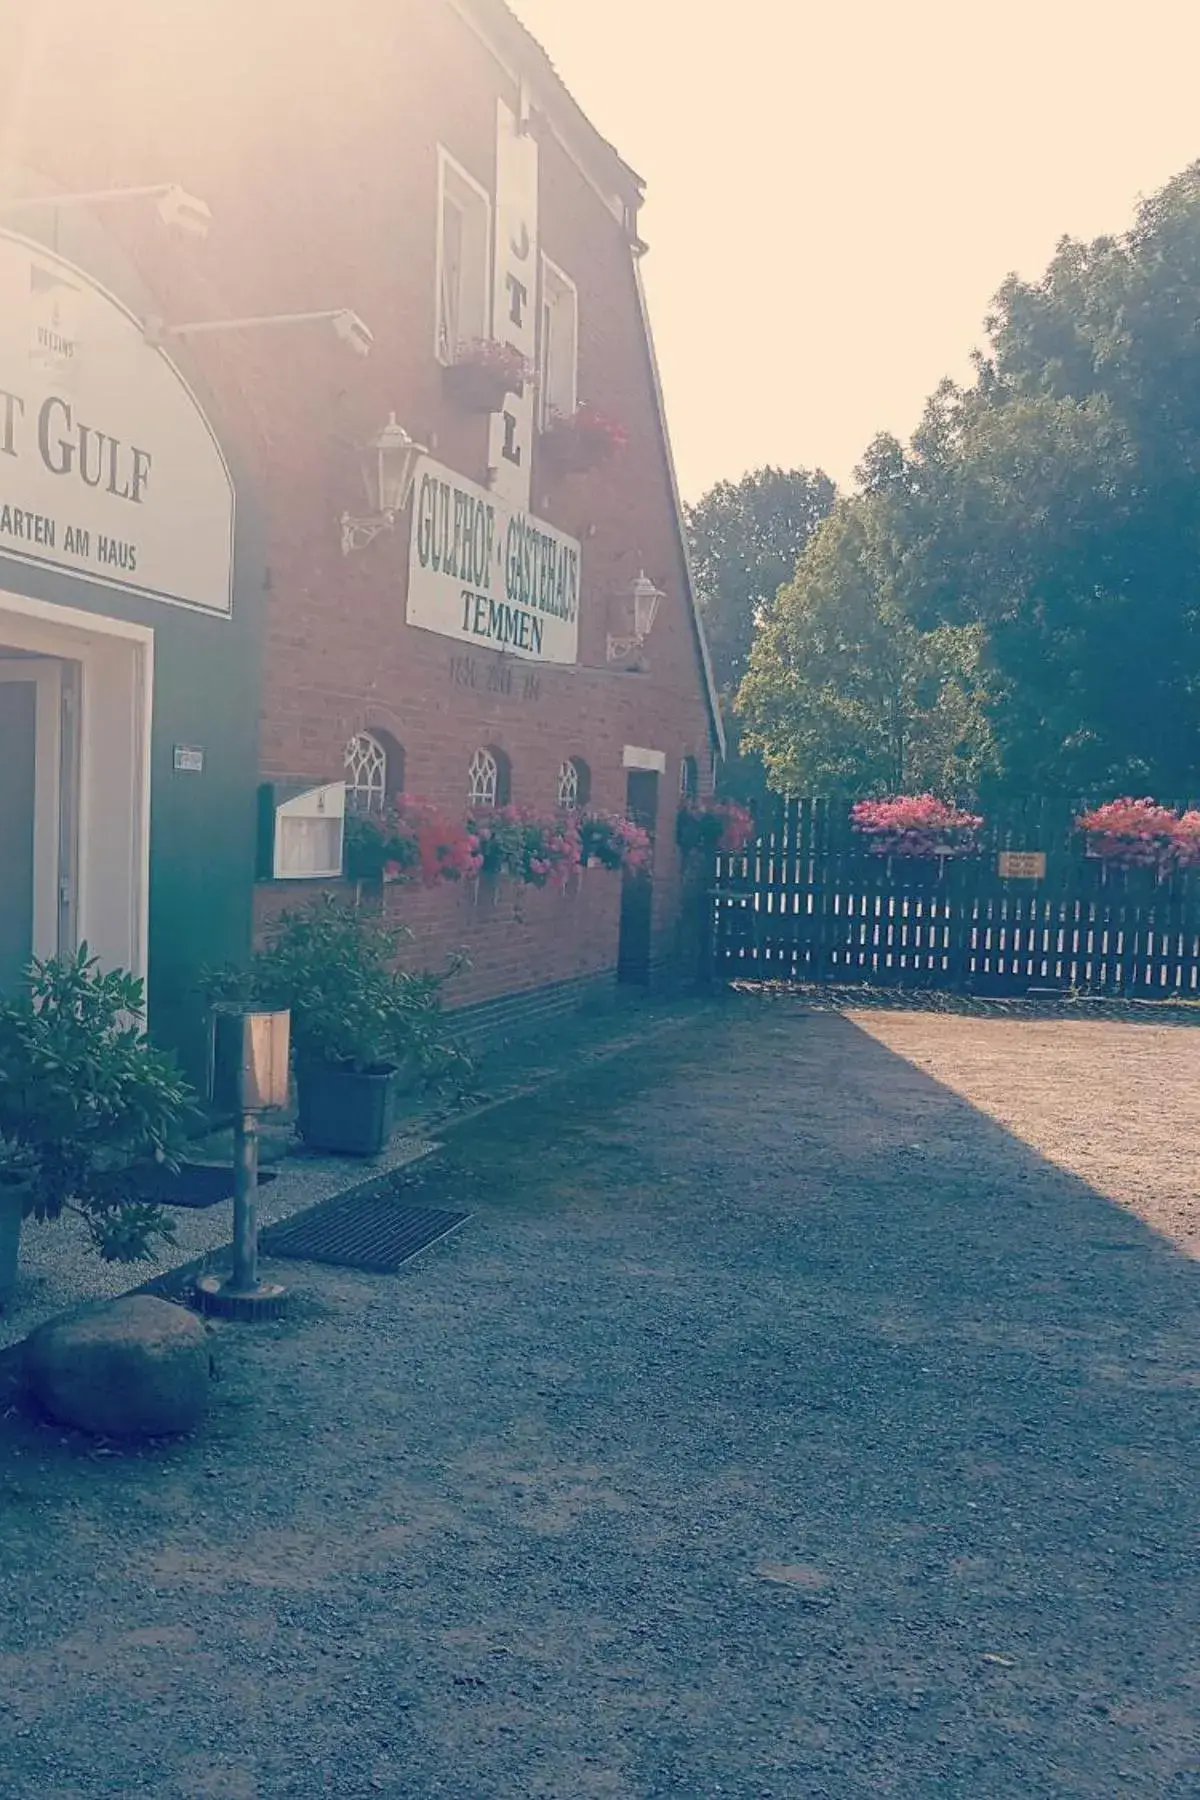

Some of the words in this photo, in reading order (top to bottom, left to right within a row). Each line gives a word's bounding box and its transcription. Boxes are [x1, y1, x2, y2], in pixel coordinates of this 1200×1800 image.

[38, 396, 152, 504] GULF
[63, 525, 90, 557] AM
[98, 534, 137, 571] HAUS
[461, 589, 544, 654] TEMMEN
